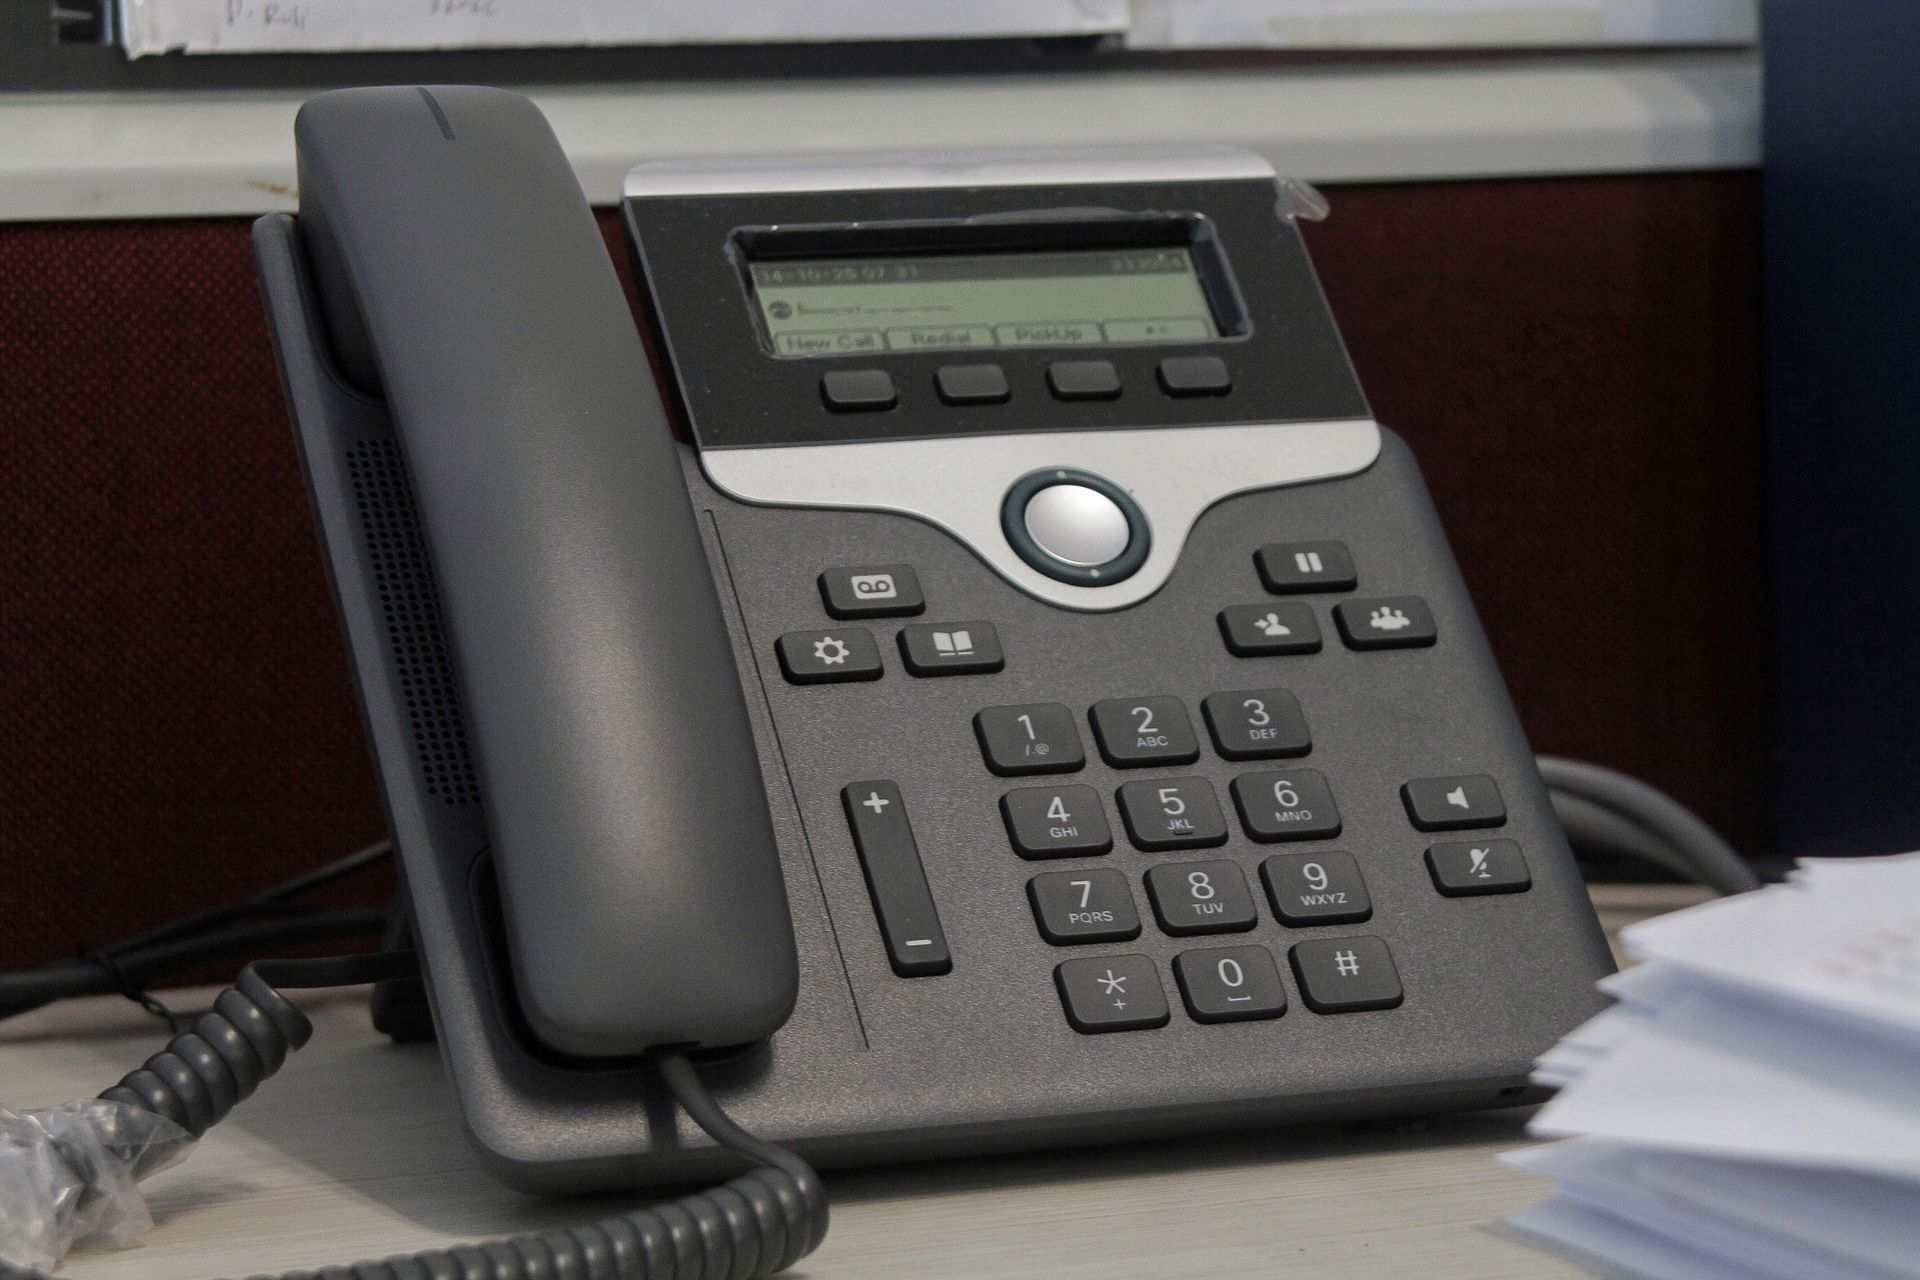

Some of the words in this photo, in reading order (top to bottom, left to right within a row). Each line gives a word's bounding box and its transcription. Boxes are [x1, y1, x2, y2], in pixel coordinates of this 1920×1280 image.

[787, 334, 831, 349] New
[838, 332, 876, 348] Call
[911, 328, 972, 345] Redial
[1015, 326, 1083, 342] PickUp
[1132, 707, 1157, 732] 2
[1244, 699, 1269, 725] 3
[1017, 714, 1036, 740] 1
[1249, 729, 1278, 740] DEF
[1137, 736, 1168, 747] ABC
[1159, 788, 1185, 814] 5
[1275, 781, 1298, 807] 6
[1048, 797, 1070, 821] 4
[1276, 810, 1312, 821] MNO
[1050, 826, 1079, 838] GHI
[1168, 819, 1194, 829] JKL
[1188, 872, 1214, 898] 8
[1303, 863, 1327, 890] 9
[1071, 881, 1090, 907] 7
[1301, 893, 1347, 905] WXYZ
[1069, 911, 1113, 923] PQRS
[1192, 903, 1222, 914] TUV
[1218, 959, 1243, 986] 0
[1335, 951, 1359, 975] #
